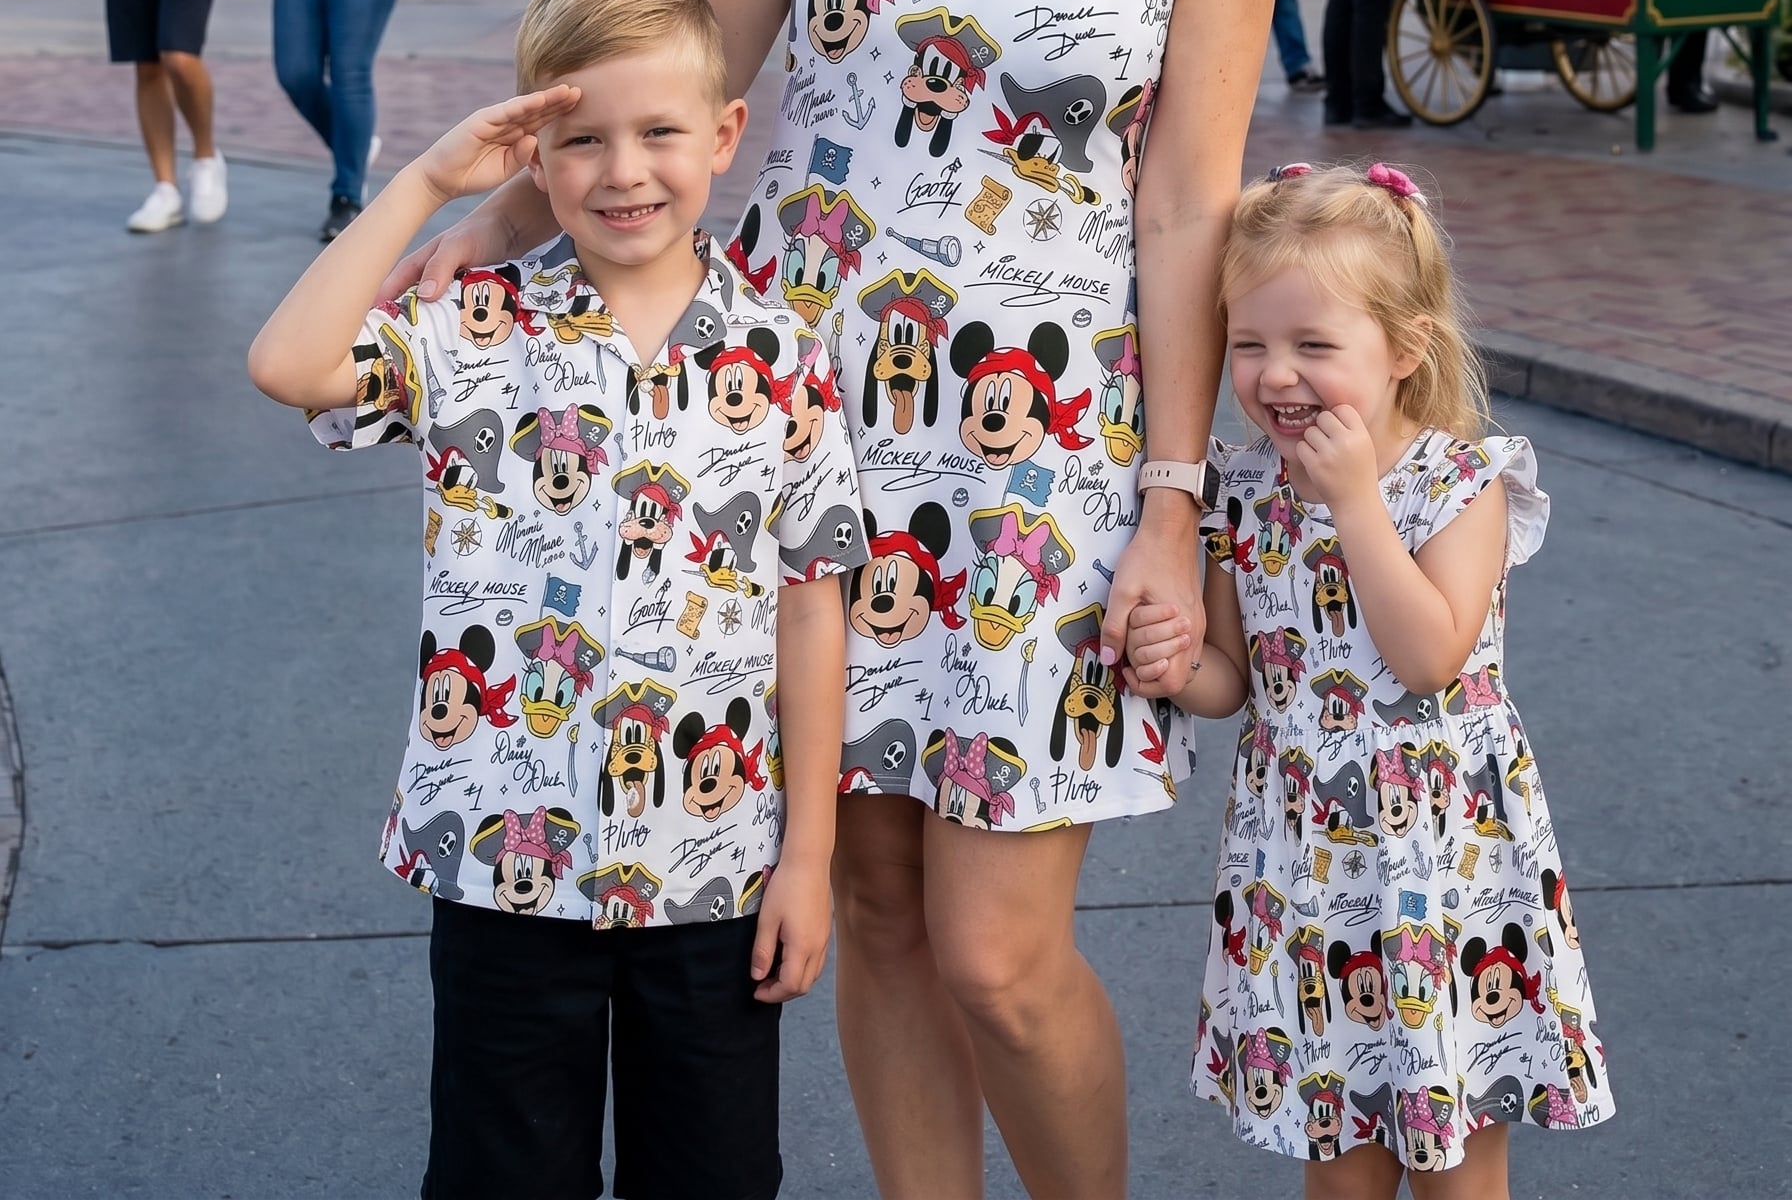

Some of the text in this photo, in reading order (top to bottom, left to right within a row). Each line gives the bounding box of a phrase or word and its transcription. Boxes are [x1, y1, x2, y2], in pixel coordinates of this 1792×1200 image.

[1059, 273, 1111, 295] MOUSE
[936, 452, 986, 474] MOUSE
[482, 582, 528, 596] MOUSE
